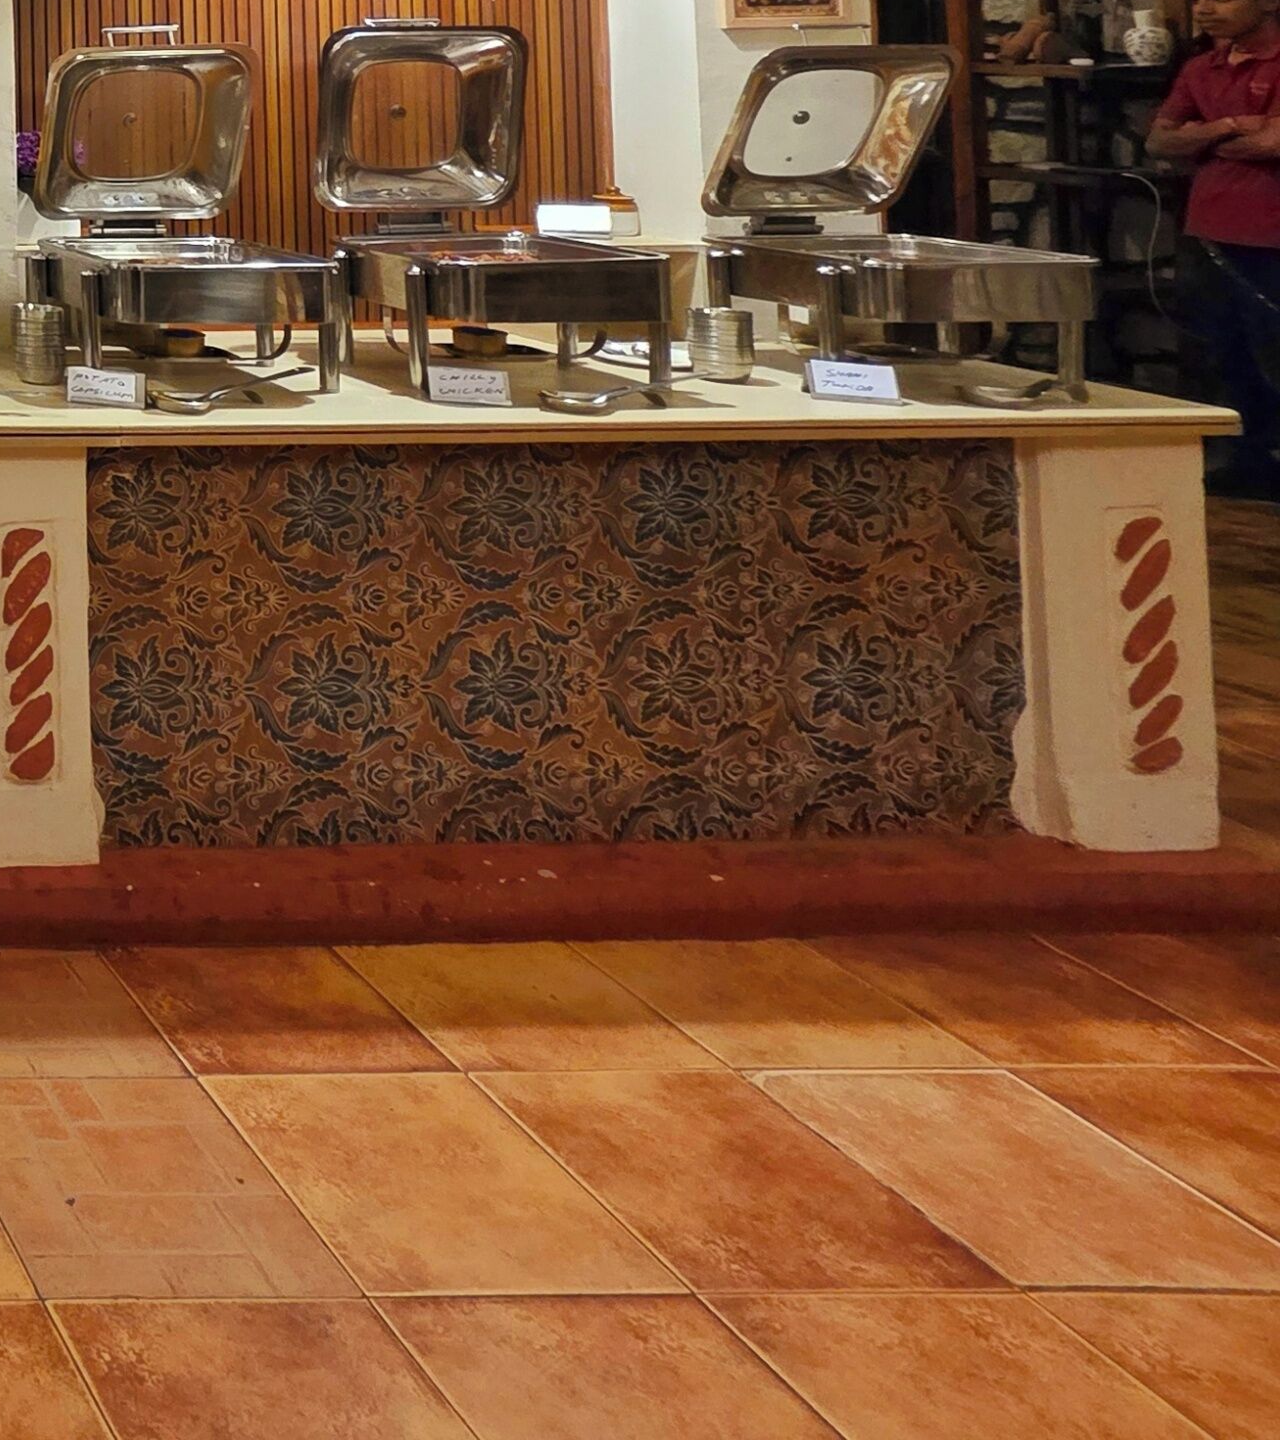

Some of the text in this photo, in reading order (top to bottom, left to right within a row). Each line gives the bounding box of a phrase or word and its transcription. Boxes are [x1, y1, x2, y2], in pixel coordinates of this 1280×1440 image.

[73, 373, 126, 387] POTATO
[439, 373, 497, 385] CHILLY
[70, 385, 134, 400] CAPSICUM
[439, 387, 505, 395] CHICKEN
